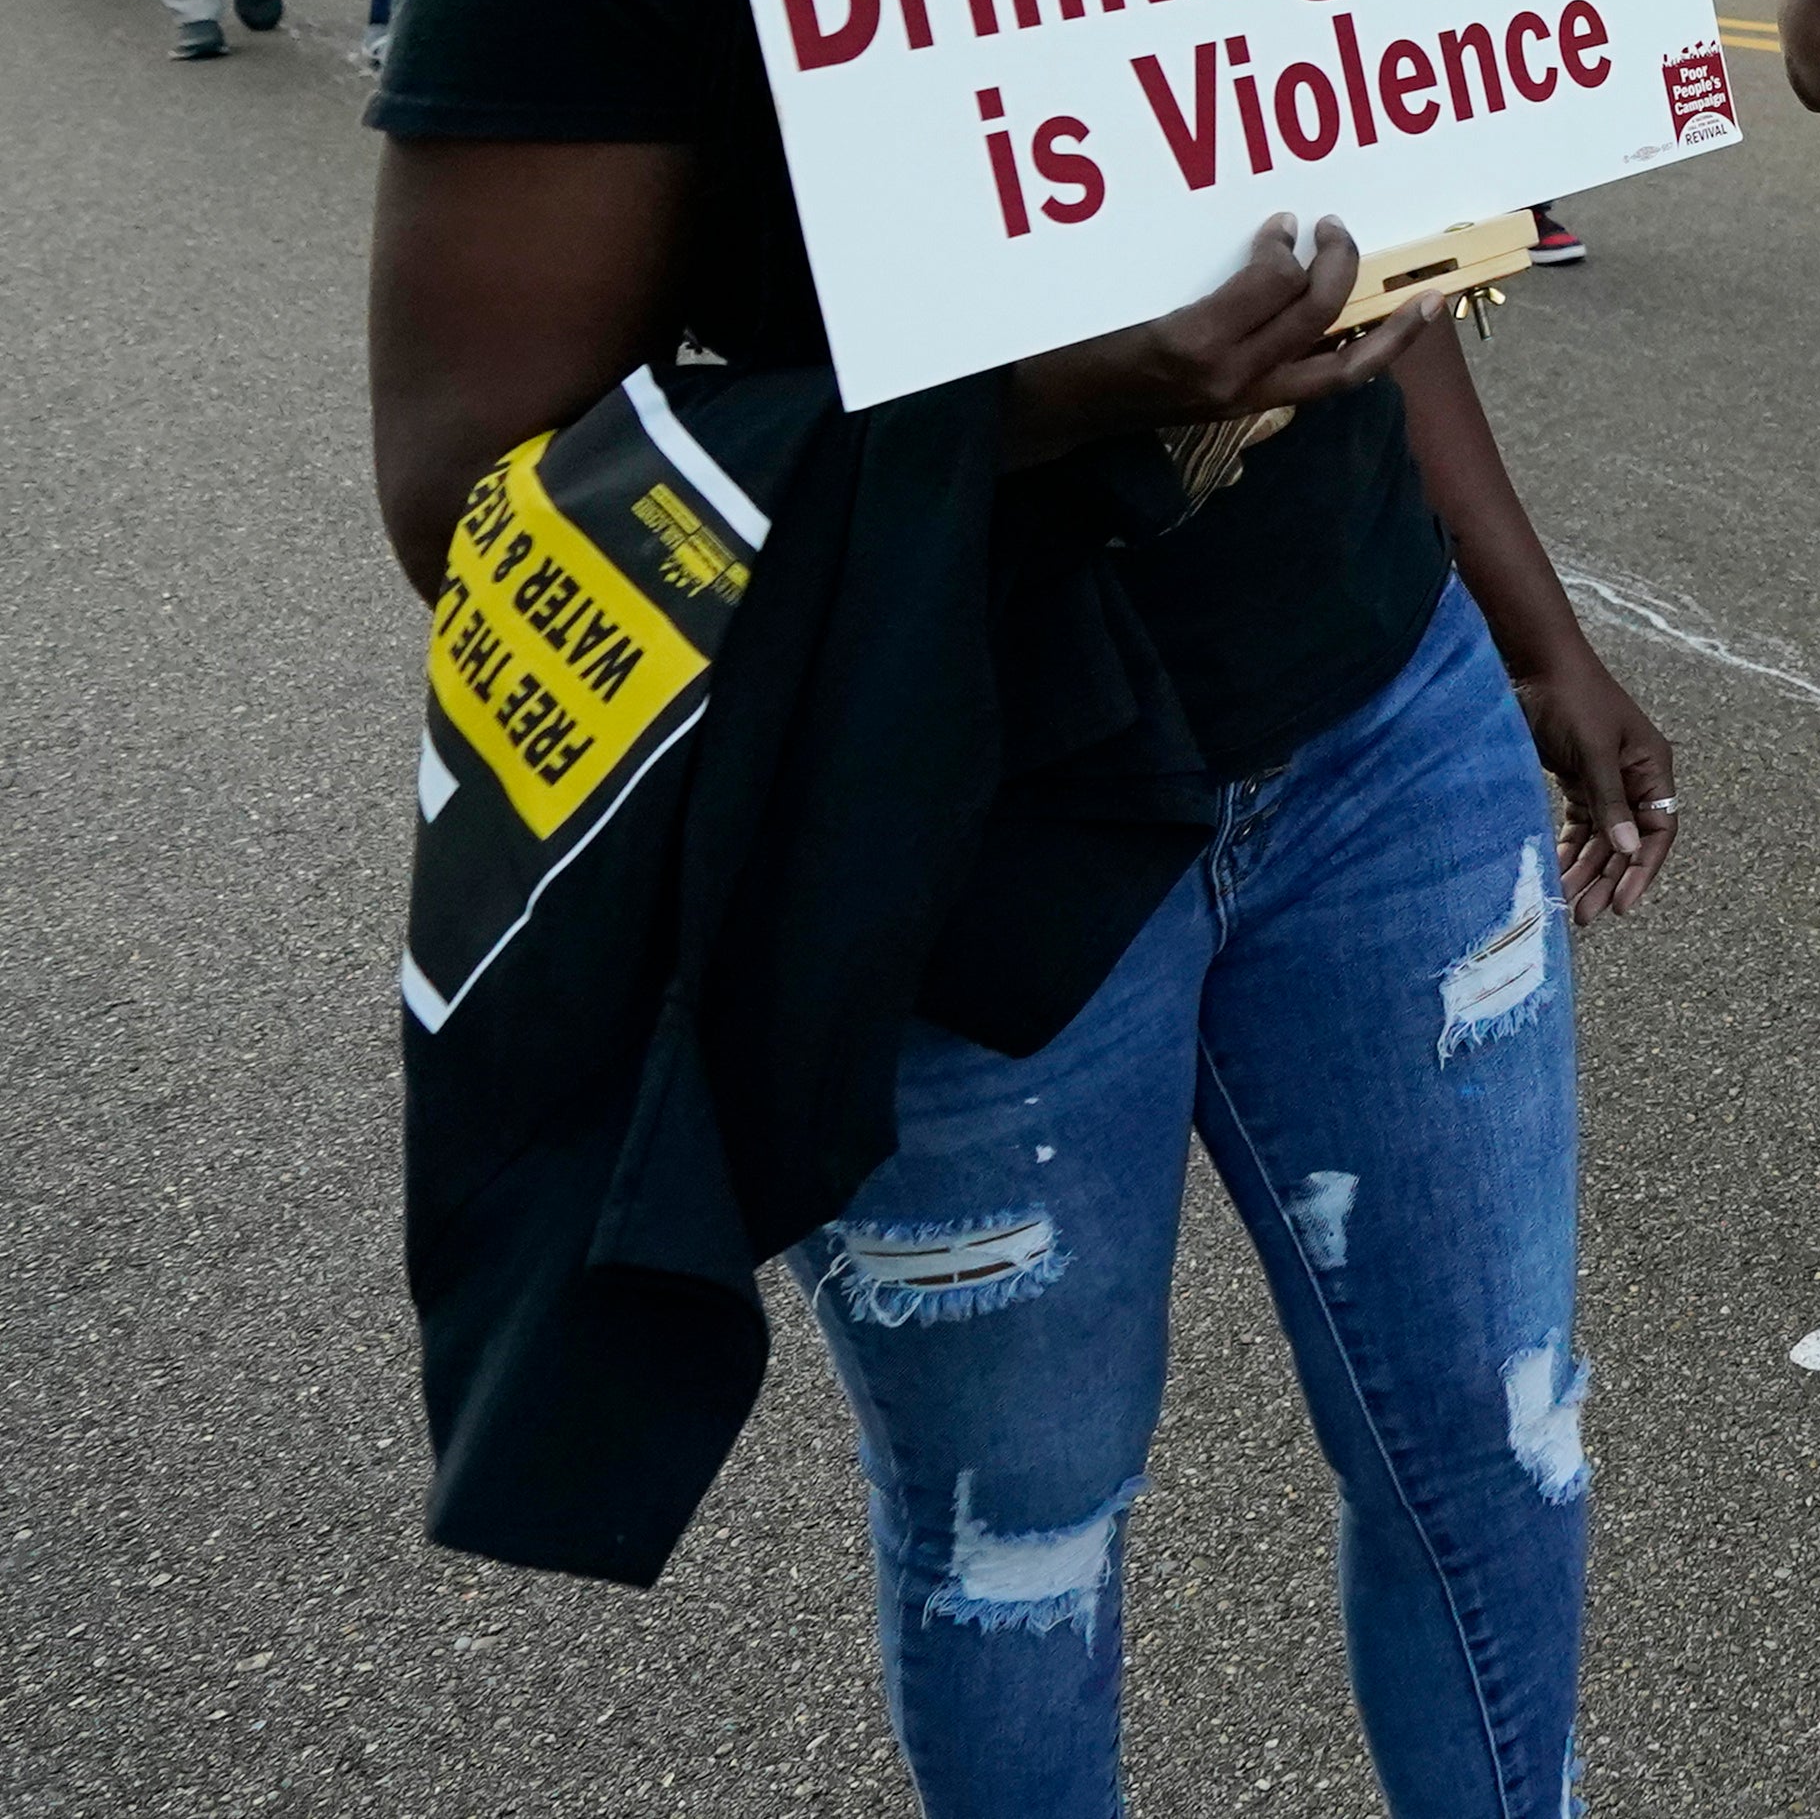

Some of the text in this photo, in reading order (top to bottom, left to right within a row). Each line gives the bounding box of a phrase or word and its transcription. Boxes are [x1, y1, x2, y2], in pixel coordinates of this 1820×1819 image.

[1672, 75, 1722, 101] People's
[1679, 64, 1709, 84] Poor
[975, 0, 1611, 238] is Violence
[1674, 92, 1727, 115] Campaign
[1685, 123, 1728, 146] REVIVAL
[487, 534, 536, 585] &
[511, 556, 646, 704] WATER
[447, 609, 516, 704] THE
[496, 673, 595, 786] FREE
